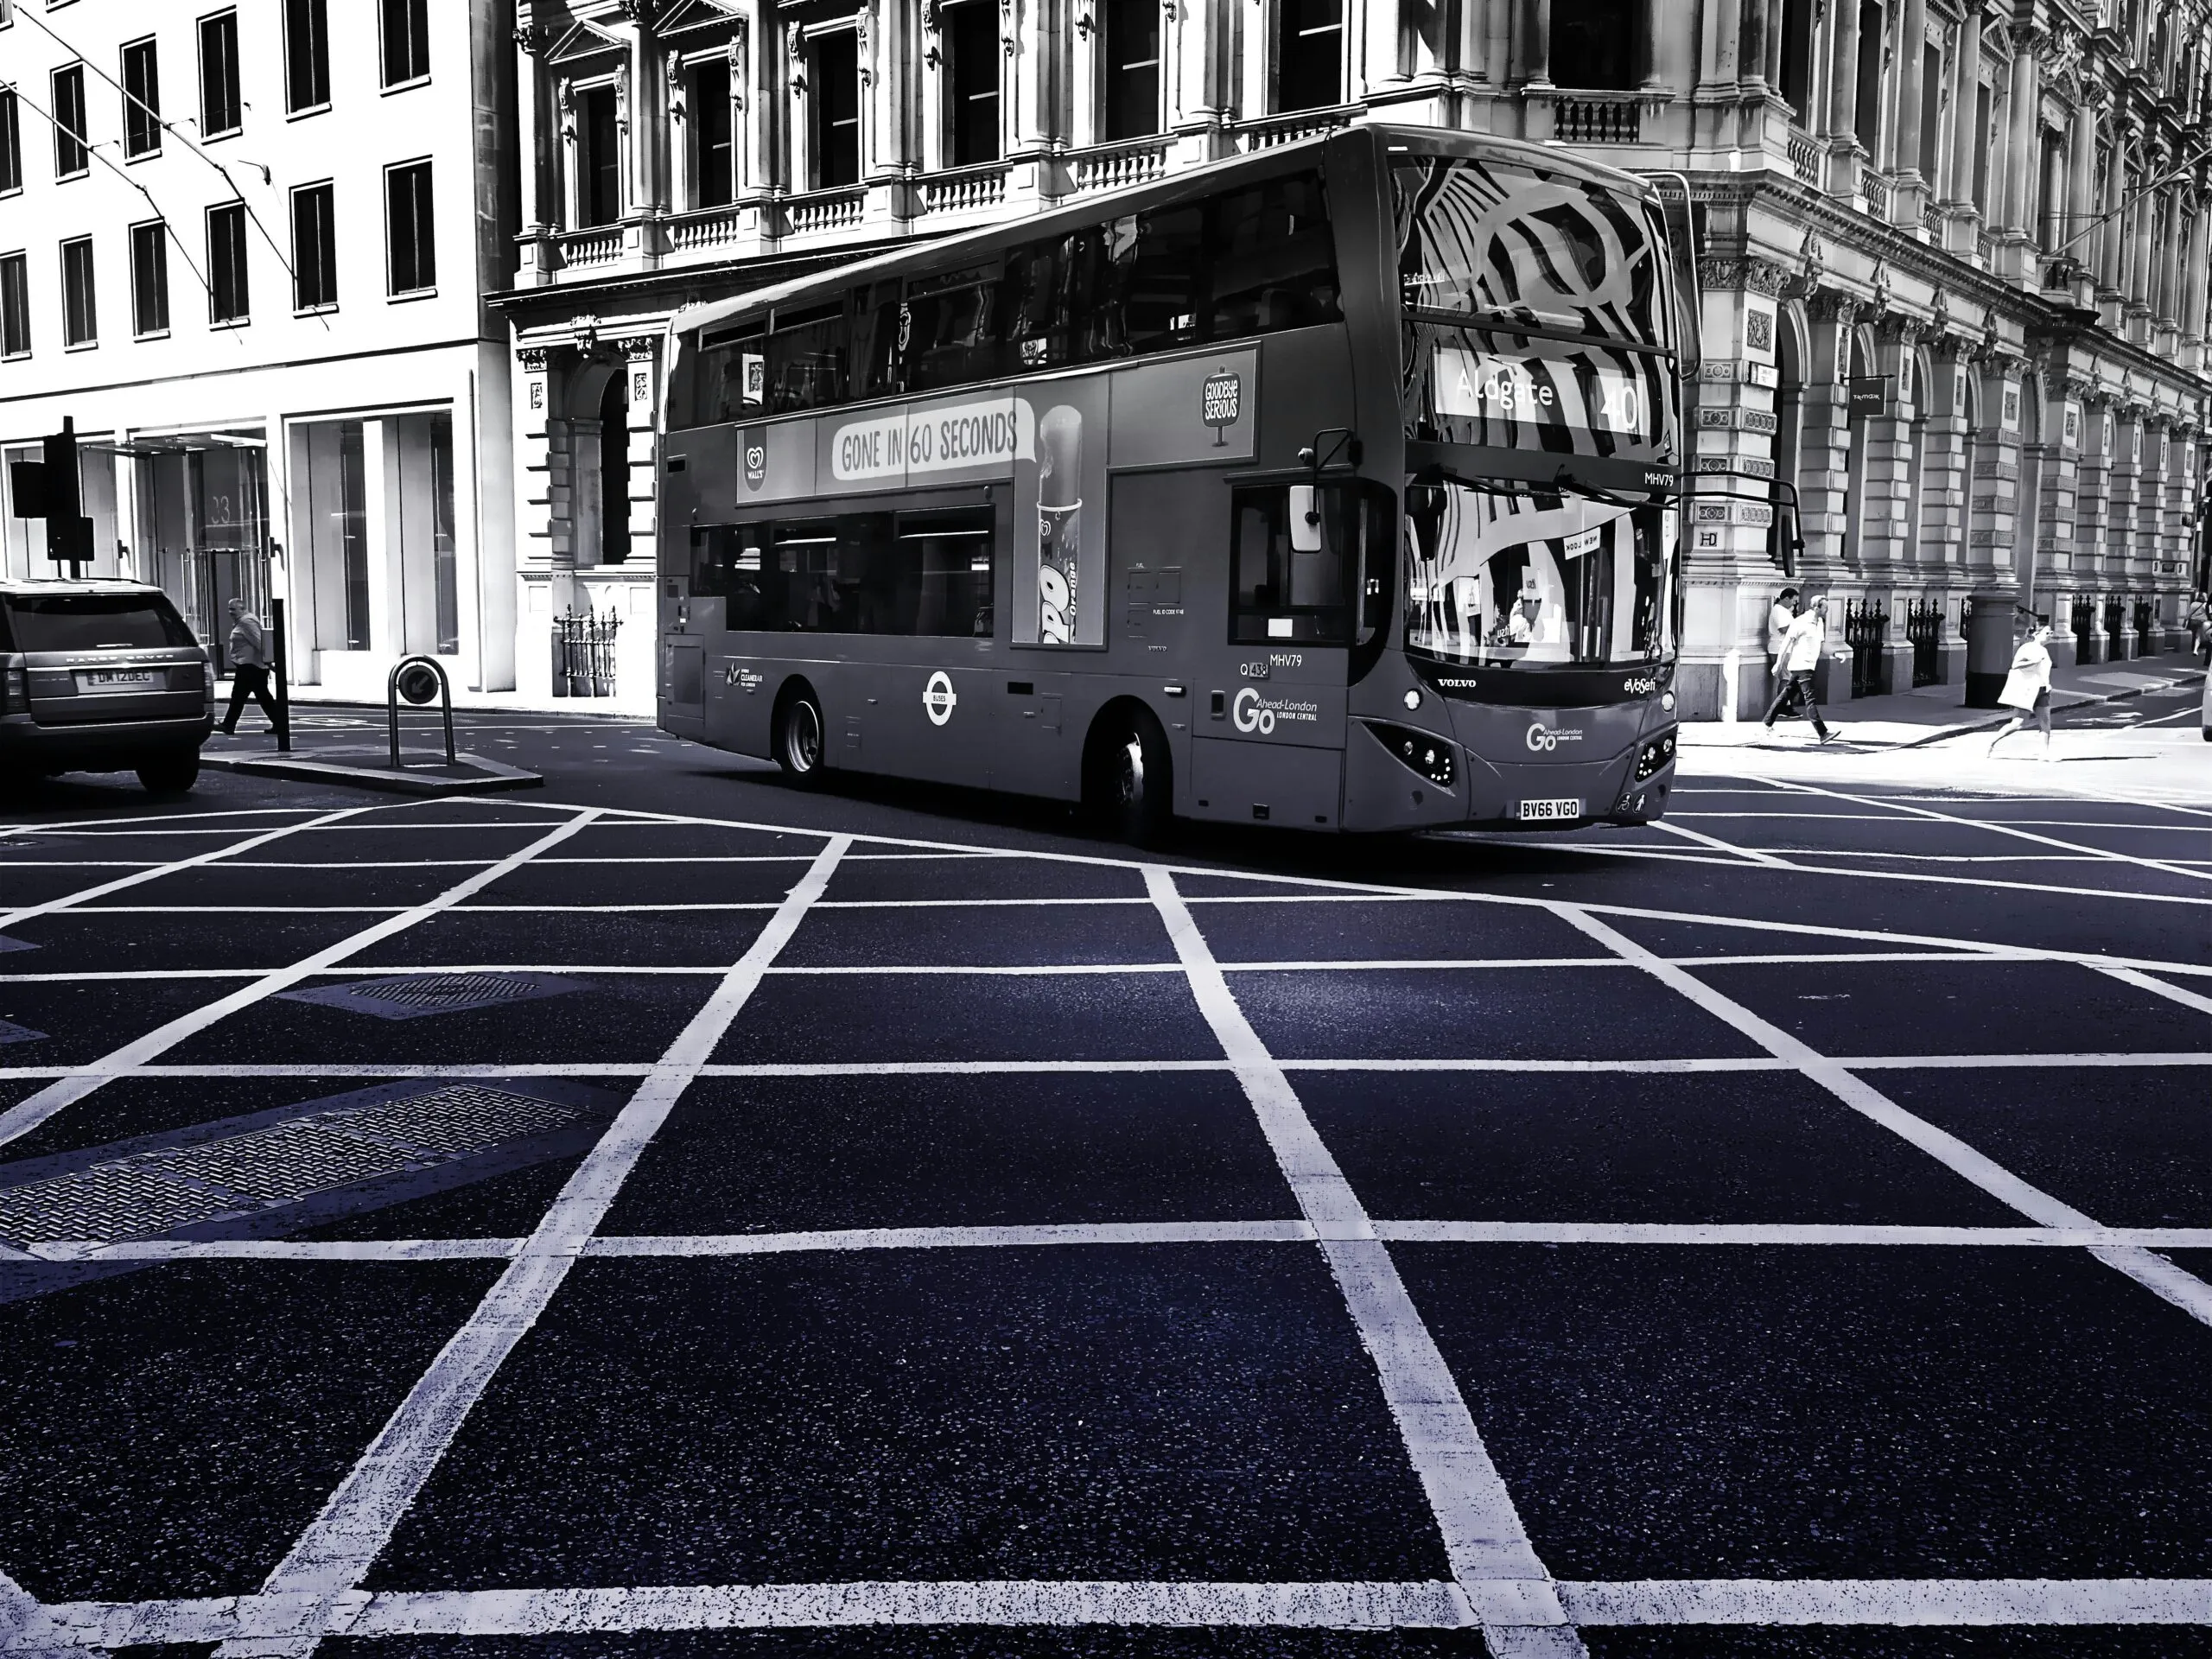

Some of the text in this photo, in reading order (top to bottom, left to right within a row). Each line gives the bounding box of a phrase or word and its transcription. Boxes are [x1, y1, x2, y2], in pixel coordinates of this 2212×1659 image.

[1456, 367, 1553, 410] Aldgate
[1600, 385, 1638, 431] 40
[842, 410, 1017, 472] GONE IN 60 SECONDS
[1644, 472, 1674, 486] MHV79
[1269, 654, 1302, 667] MHV79
[1240, 663, 1267, 676] Q 438
[1438, 678, 1477, 688] VOLVO
[1233, 687, 1275, 734] Go
[1297, 713, 1317, 721] CENTRAL
[1526, 722, 1556, 752] Go
[1523, 801, 1578, 817] BV66 VGO
